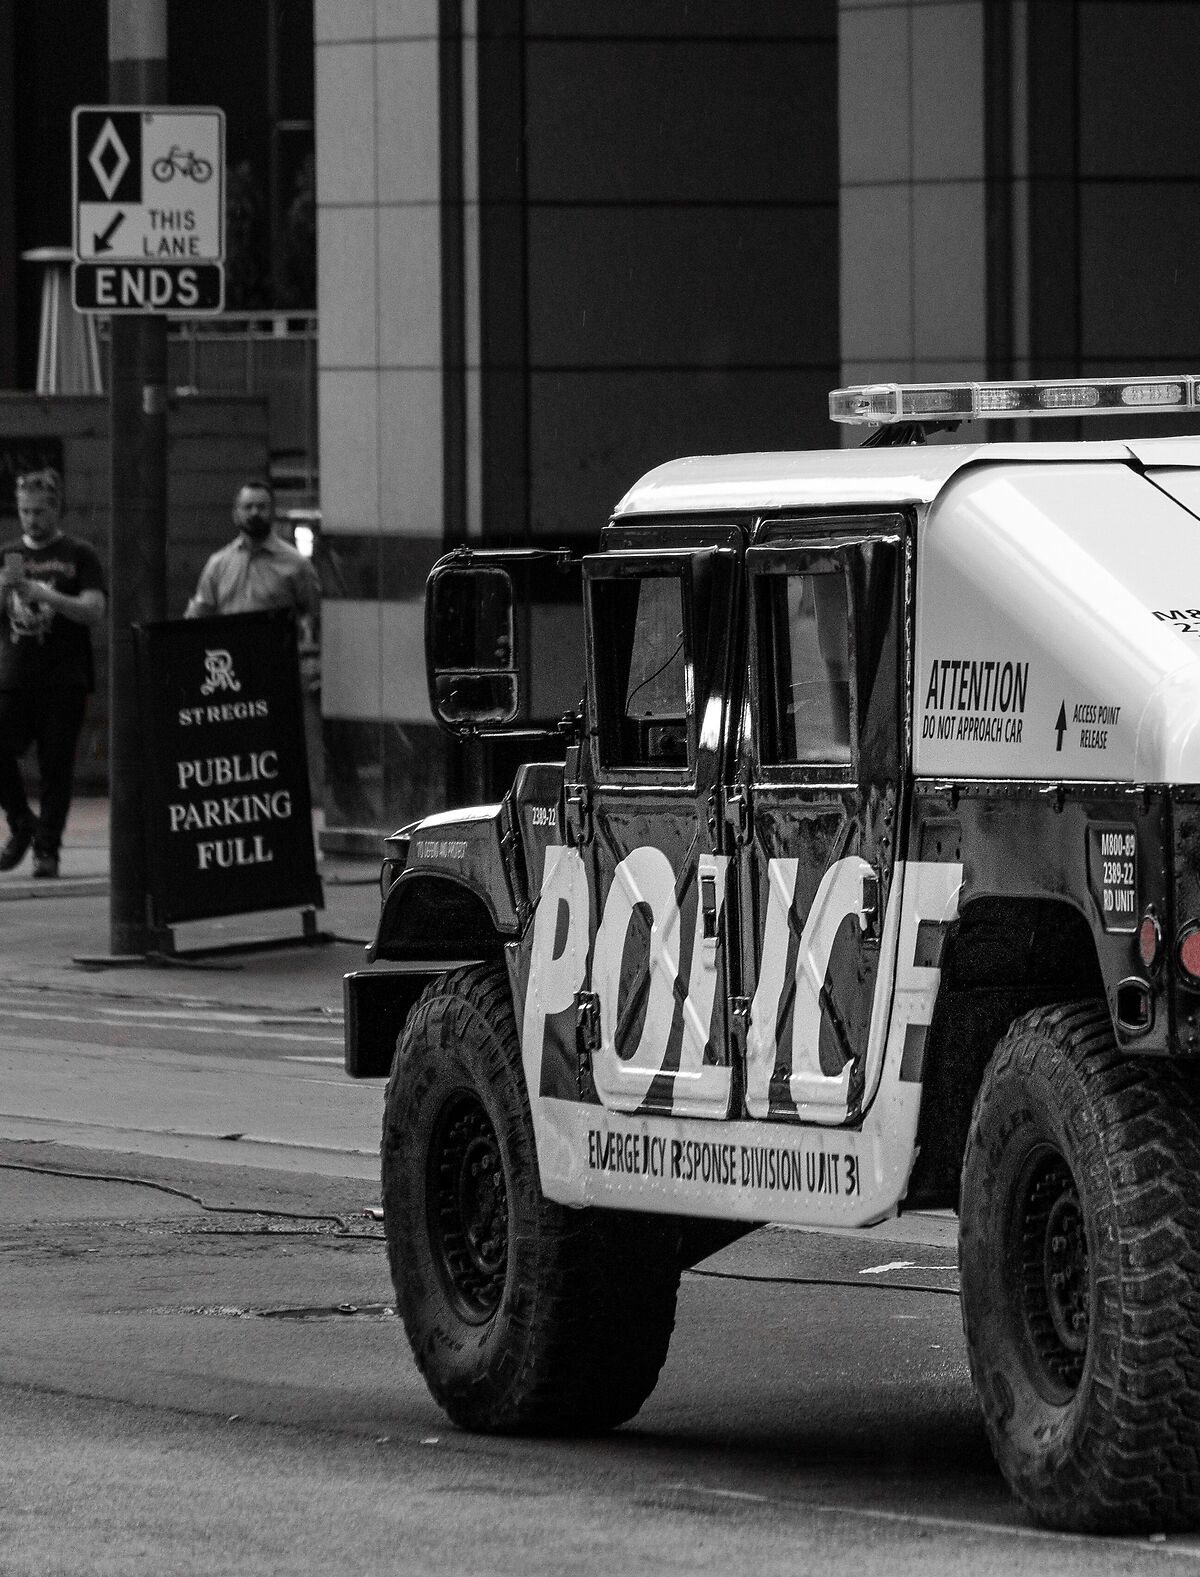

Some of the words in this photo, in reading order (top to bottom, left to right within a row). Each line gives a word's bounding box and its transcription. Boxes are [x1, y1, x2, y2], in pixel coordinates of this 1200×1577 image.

[149, 209, 196, 231] THIS
[143, 236, 200, 257] LANE
[96, 268, 199, 306] ENDS
[925, 660, 1029, 713] ATTENTION
[1073, 704, 1097, 724] ACCESS
[1098, 706, 1121, 725] POINT
[921, 715, 936, 739] DO
[937, 715, 956, 740] NOT
[956, 717, 1004, 742] APPROACH
[1004, 718, 1023, 743] CAR
[1080, 729, 1107, 750] RELEASE
[177, 751, 279, 789] PUBLIC
[168, 790, 292, 832] PARKING
[197, 835, 274, 869] FULL
[1101, 833, 1136, 857] M800-89
[1103, 861, 1134, 885] 2389-22
[1103, 889, 1114, 911] RD
[1115, 889, 1135, 912] UNIT
[522, 845, 964, 1124] POLICE
[741, 1146, 801, 1192] DIVISION
[806, 1152, 840, 1196] UNIT
